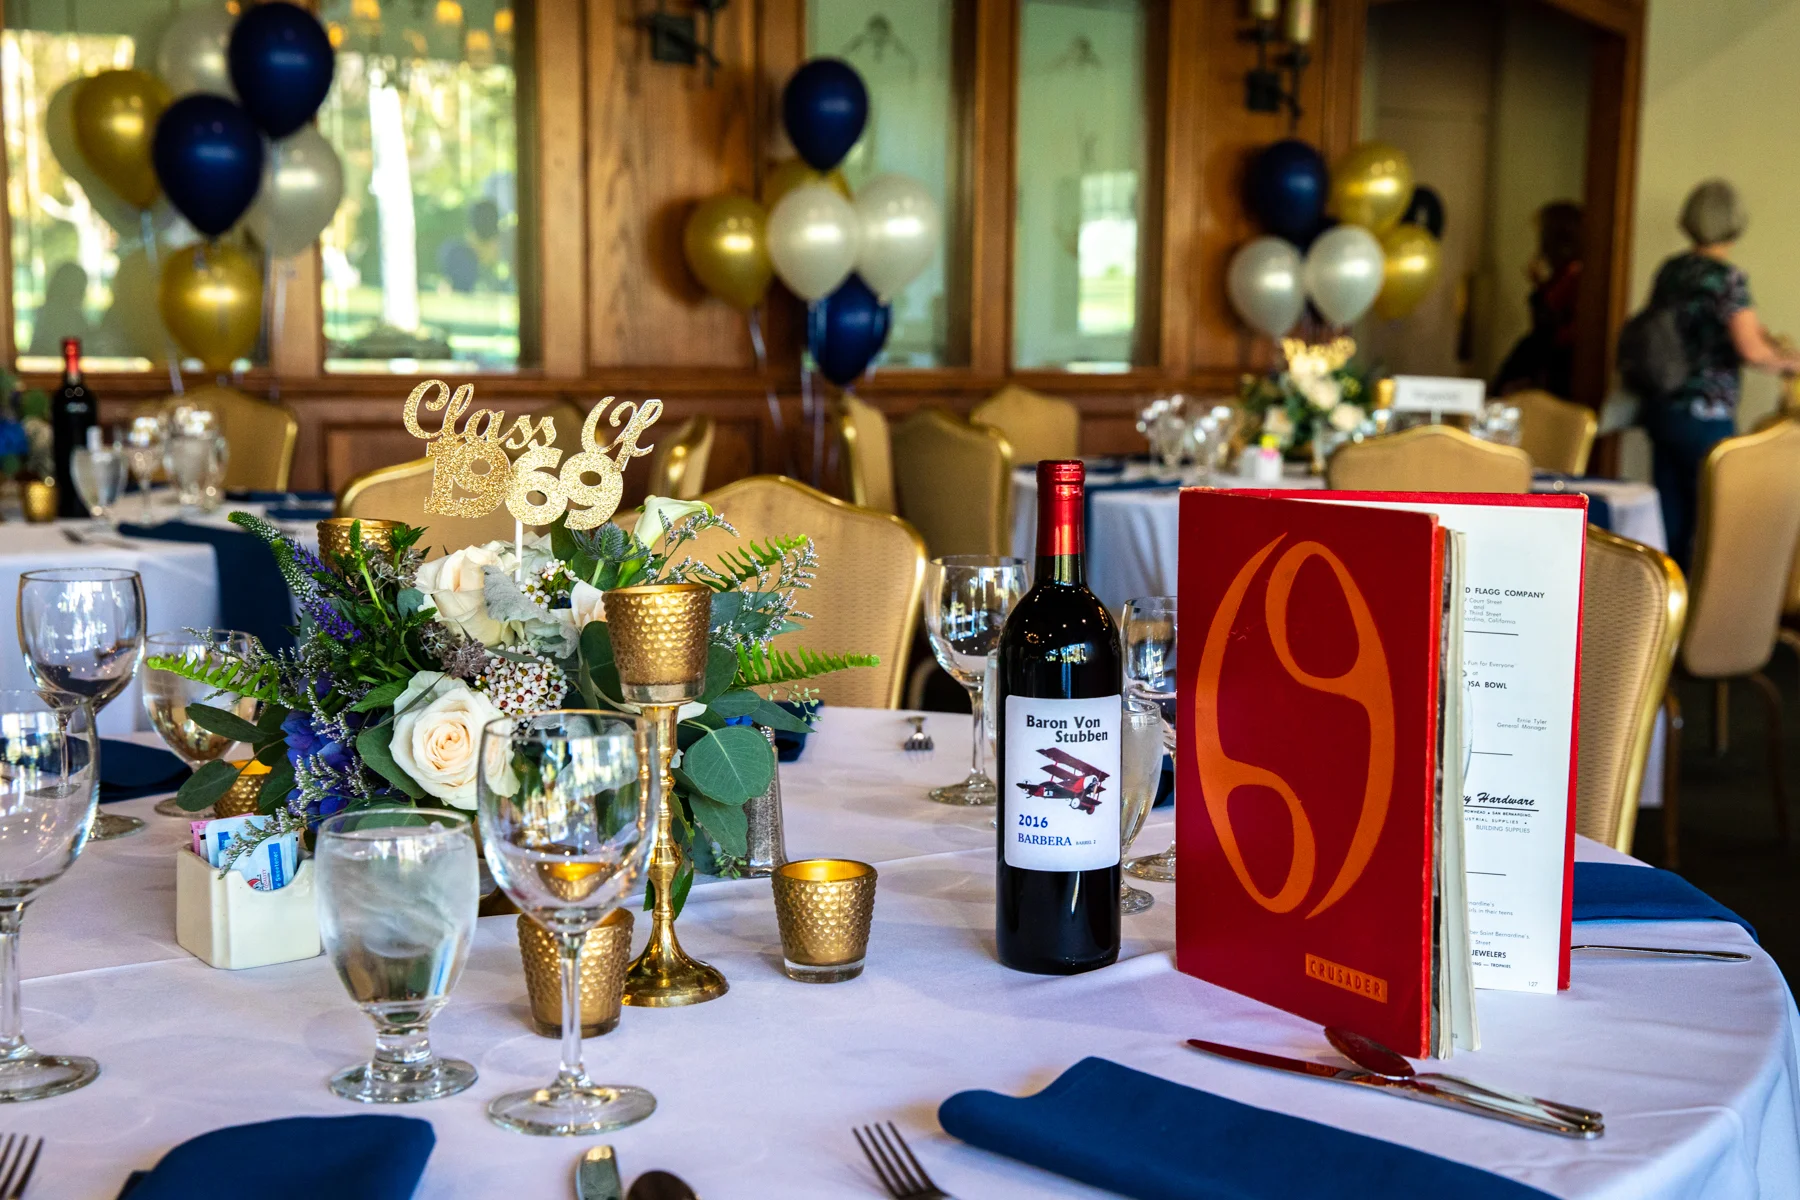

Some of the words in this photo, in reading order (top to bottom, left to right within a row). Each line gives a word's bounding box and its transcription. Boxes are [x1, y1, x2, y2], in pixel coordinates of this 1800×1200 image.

[403, 379, 557, 449] Class
[581, 396, 664, 471] Of
[424, 441, 624, 531] 1969
[1475, 587, 1501, 596] FLAGG
[1504, 589, 1545, 599] COMPANY
[1487, 617, 1516, 625] California
[1484, 681, 1508, 690] BOWL
[1026, 715, 1068, 729] Baron
[1073, 716, 1101, 729] Von
[1195, 532, 1395, 920] 69
[1521, 724, 1548, 732] Manager
[1533, 718, 1548, 726] Tyler
[1055, 730, 1109, 743] Stubben
[1477, 792, 1535, 806] Hardware
[1018, 814, 1049, 829] 2016
[1475, 824, 1504, 832] BUILDING
[1018, 832, 1072, 847] BARBERA
[1472, 950, 1506, 958] JEWELERS
[1310, 960, 1381, 997] CRUSADER
